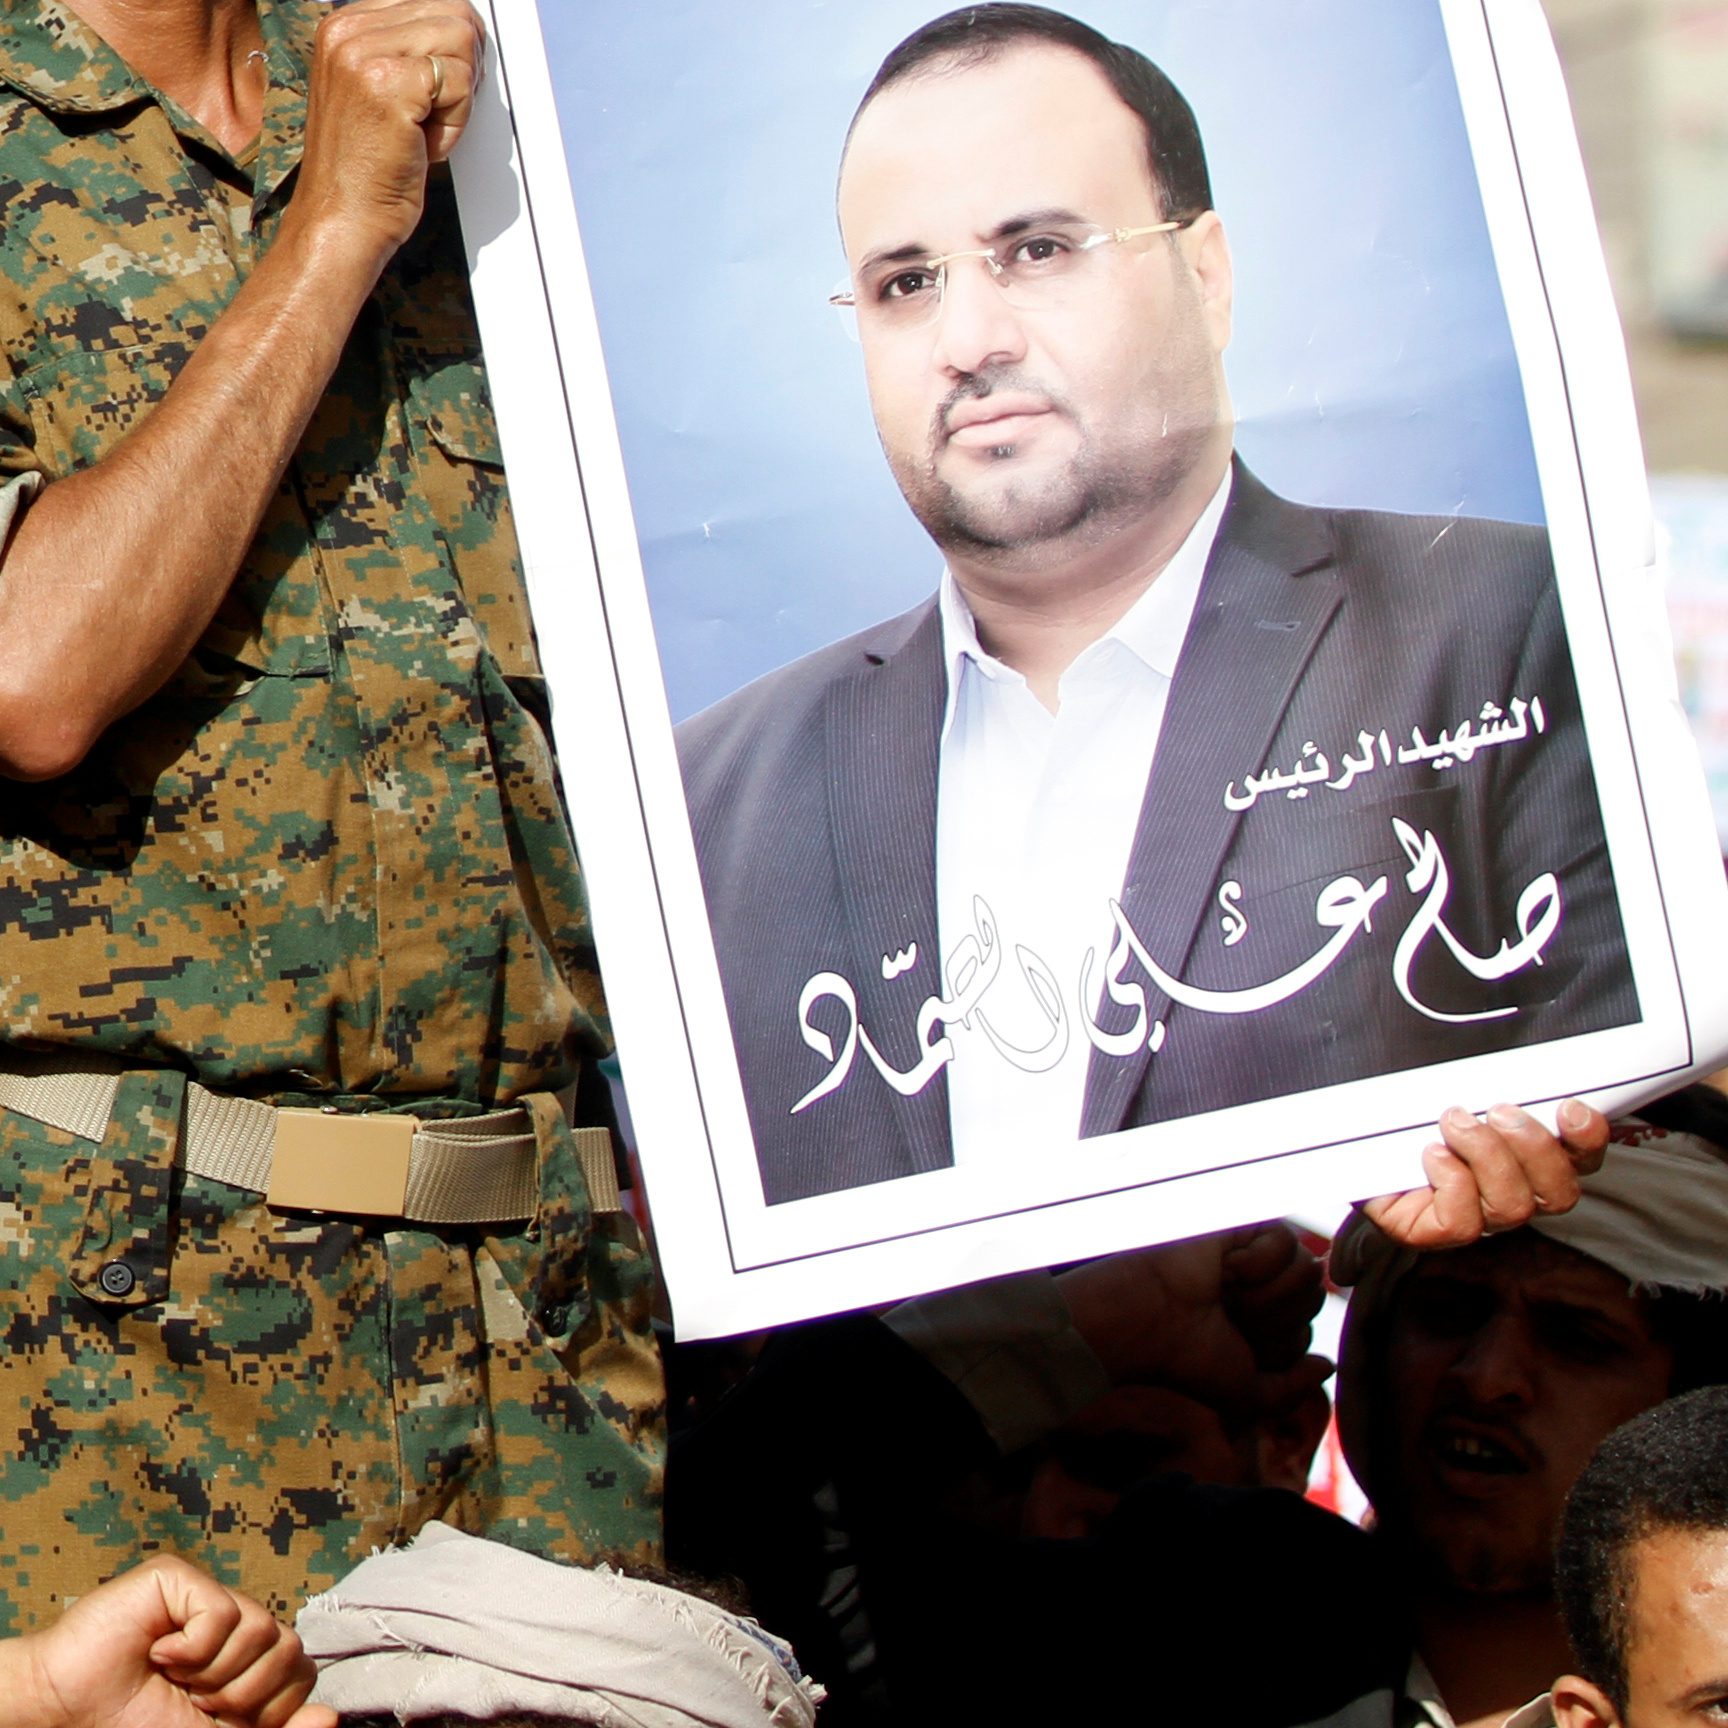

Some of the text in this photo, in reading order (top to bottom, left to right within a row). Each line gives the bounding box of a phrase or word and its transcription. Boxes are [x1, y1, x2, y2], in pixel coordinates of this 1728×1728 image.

[1222, 694, 1546, 813] الشهيد الرئيس
[1391, 815, 1562, 1023] صالح
